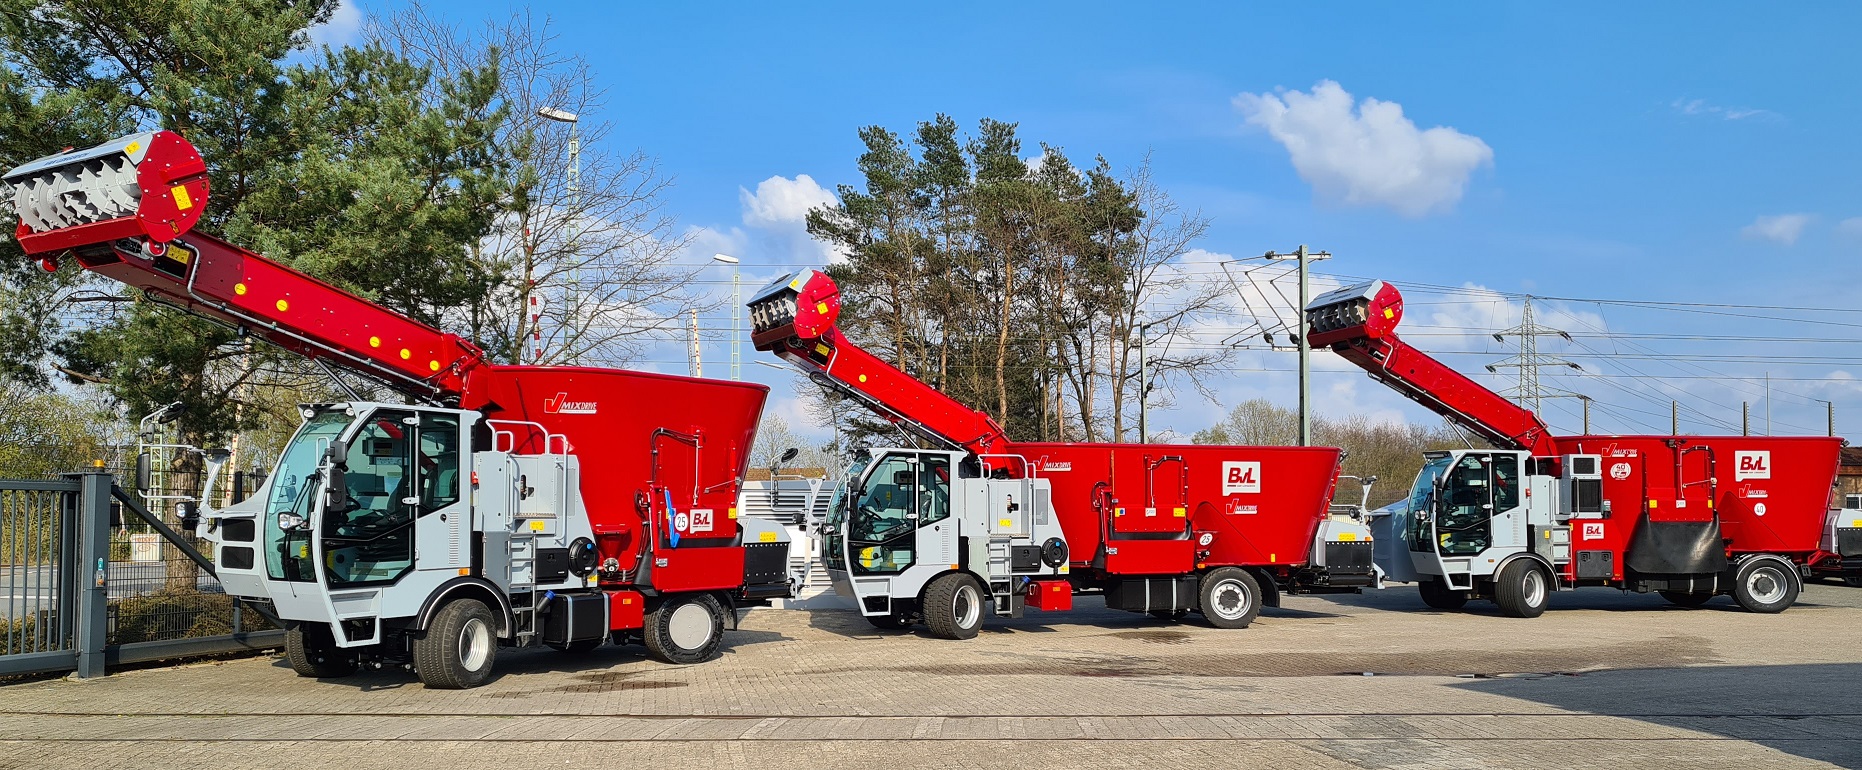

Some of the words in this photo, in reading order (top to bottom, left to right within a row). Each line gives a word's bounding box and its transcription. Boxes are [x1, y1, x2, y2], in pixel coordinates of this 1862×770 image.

[1740, 455, 1767, 470] BvL
[1228, 467, 1256, 483] BvL
[1756, 505, 1764, 513] 40
[677, 516, 686, 528] 25
[693, 513, 710, 525] BvL
[1201, 535, 1211, 544] 25
